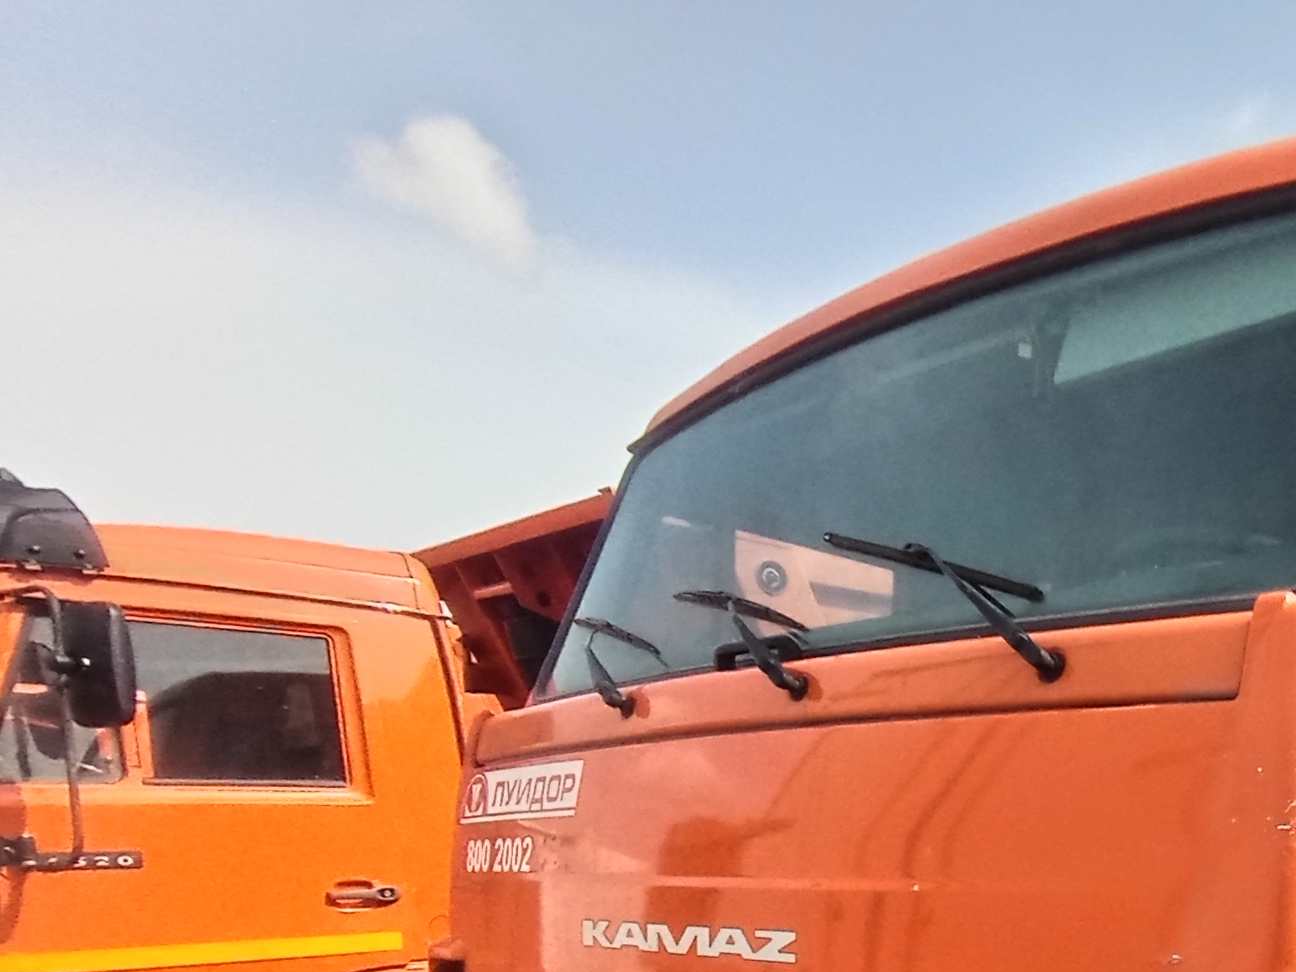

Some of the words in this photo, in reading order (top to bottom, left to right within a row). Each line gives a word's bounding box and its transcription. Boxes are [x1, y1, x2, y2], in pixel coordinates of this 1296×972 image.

[491, 773, 576, 811] ЛУИДОР
[466, 839, 491, 873] 800
[493, 837, 534, 873] 2002
[581, 918, 798, 964] KAMAZ
